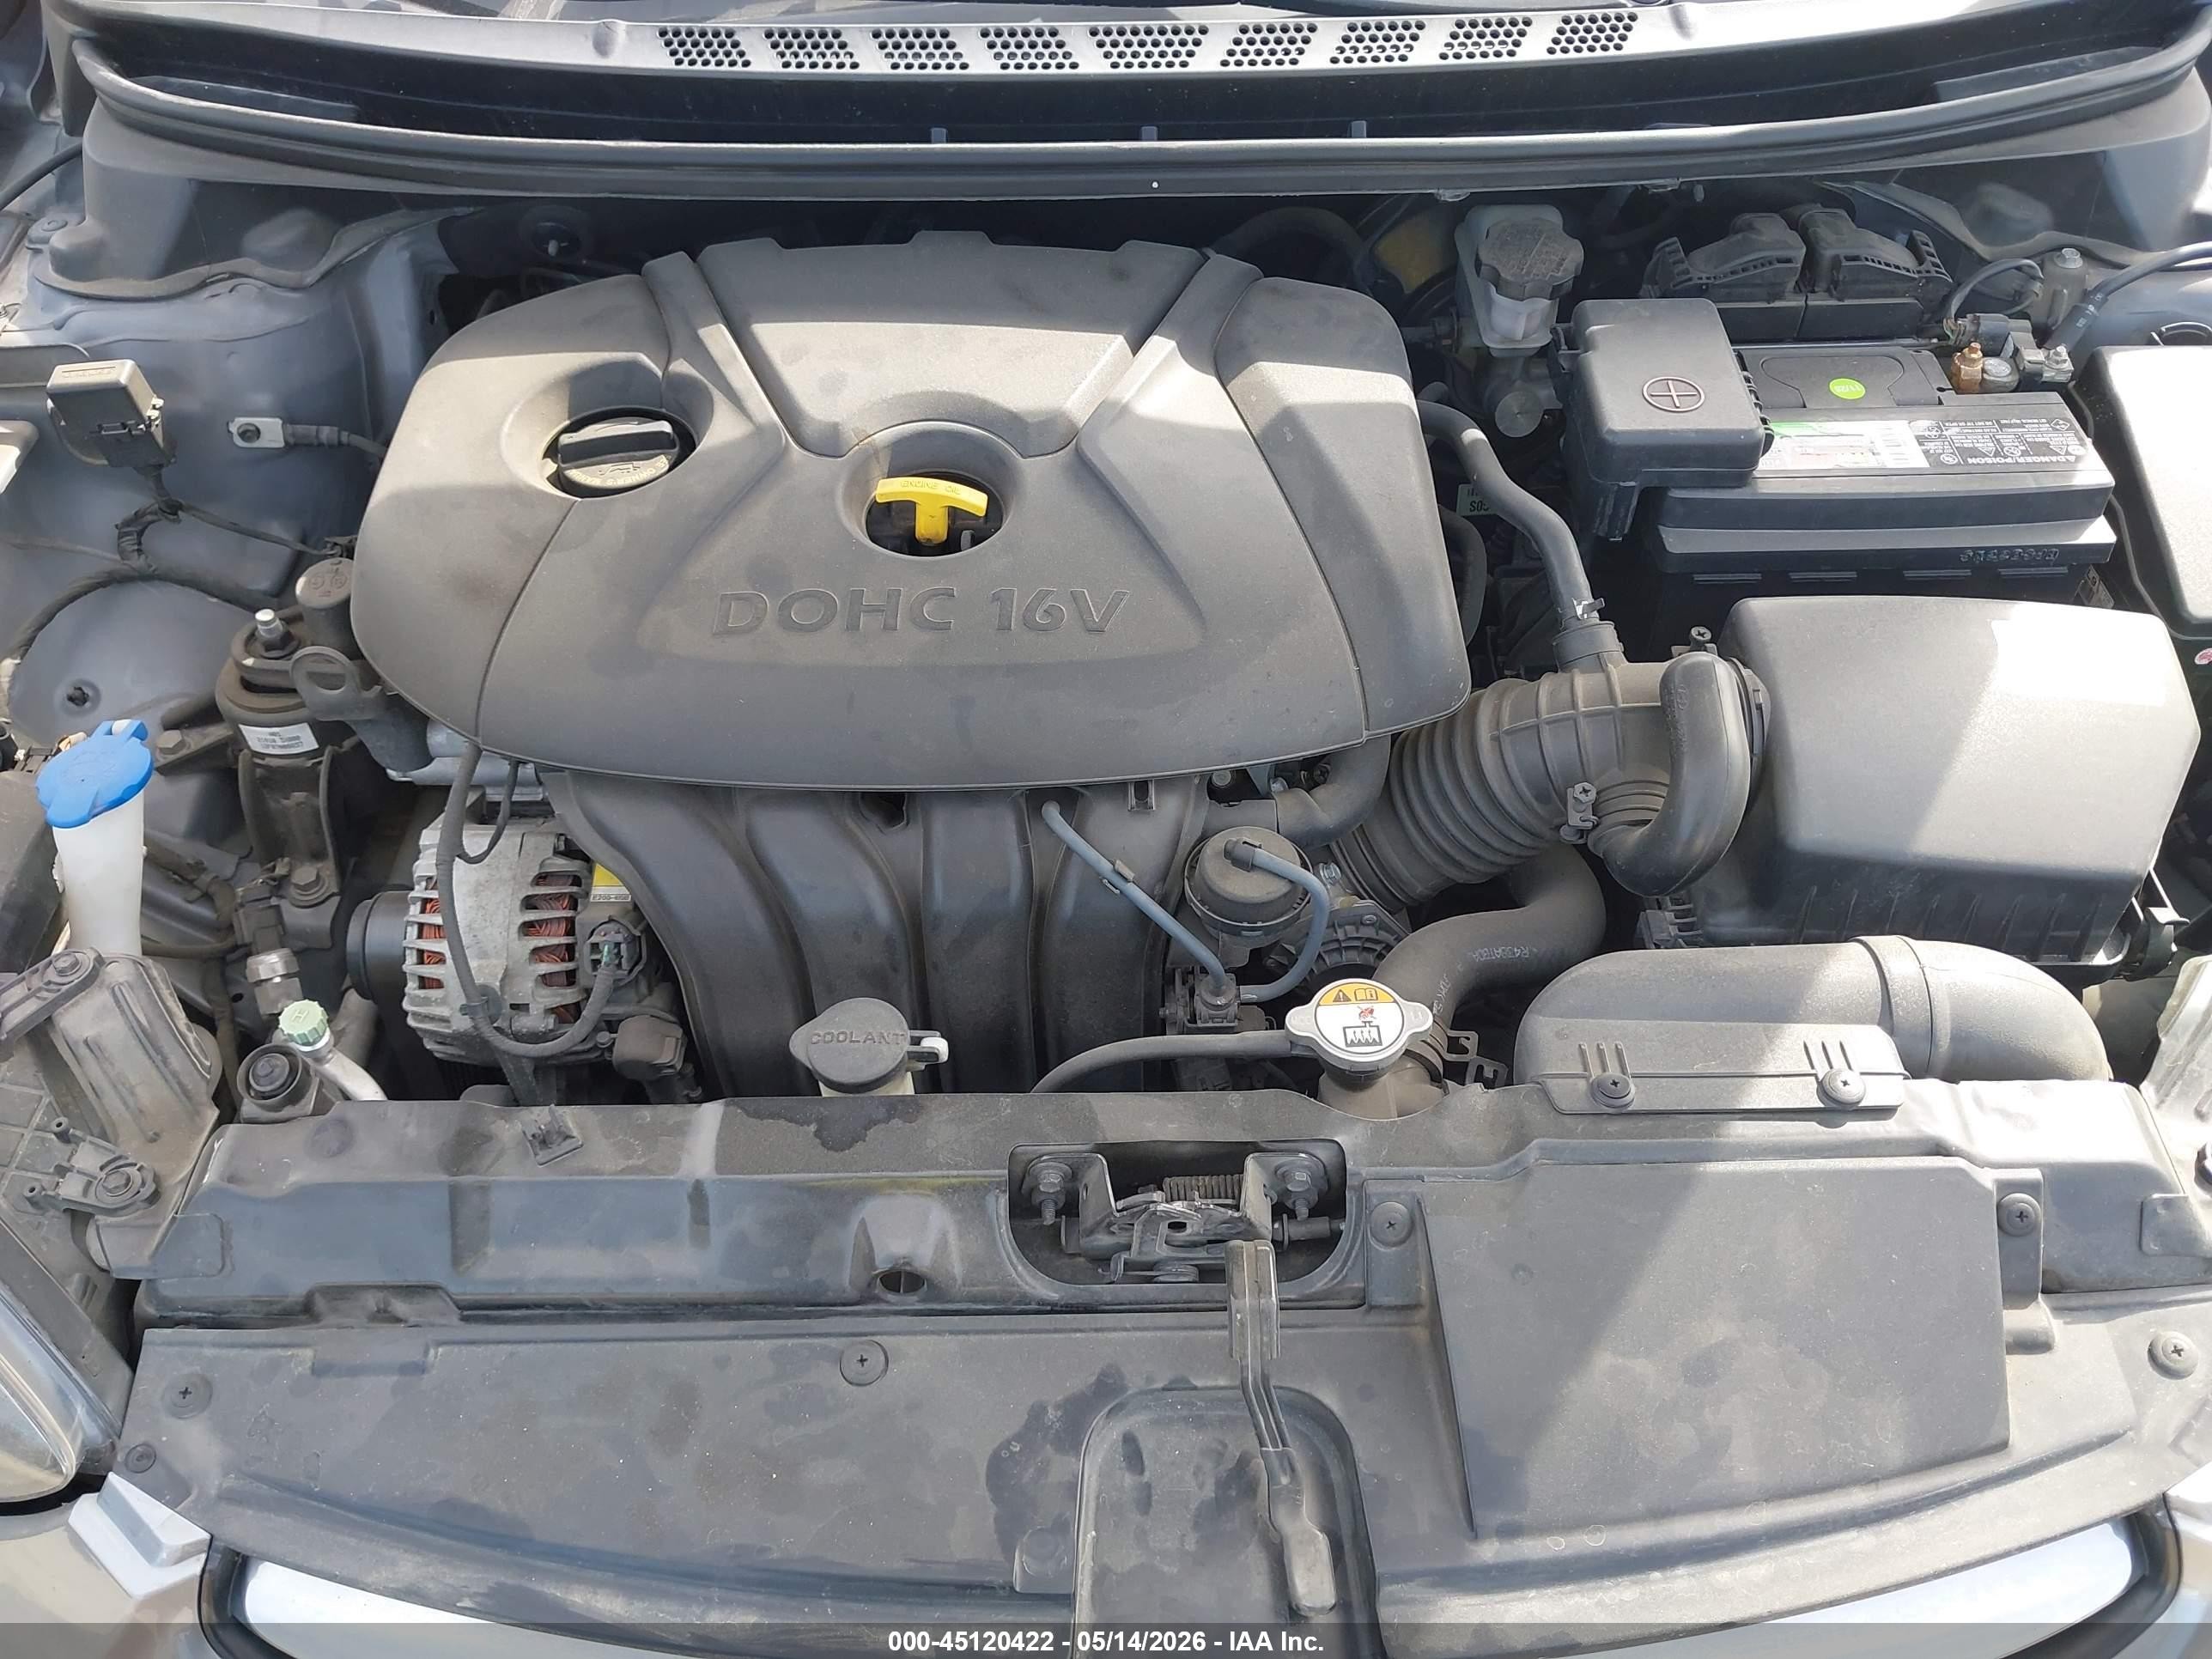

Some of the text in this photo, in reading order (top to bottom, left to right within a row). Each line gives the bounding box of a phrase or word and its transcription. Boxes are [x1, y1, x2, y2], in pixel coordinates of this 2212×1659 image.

[901, 480, 962, 495] ENGINE OIL
[712, 586, 1130, 637] DOHC 16V
[291, 1009, 309, 1023] H
[810, 1030, 906, 1045] COOLANT
